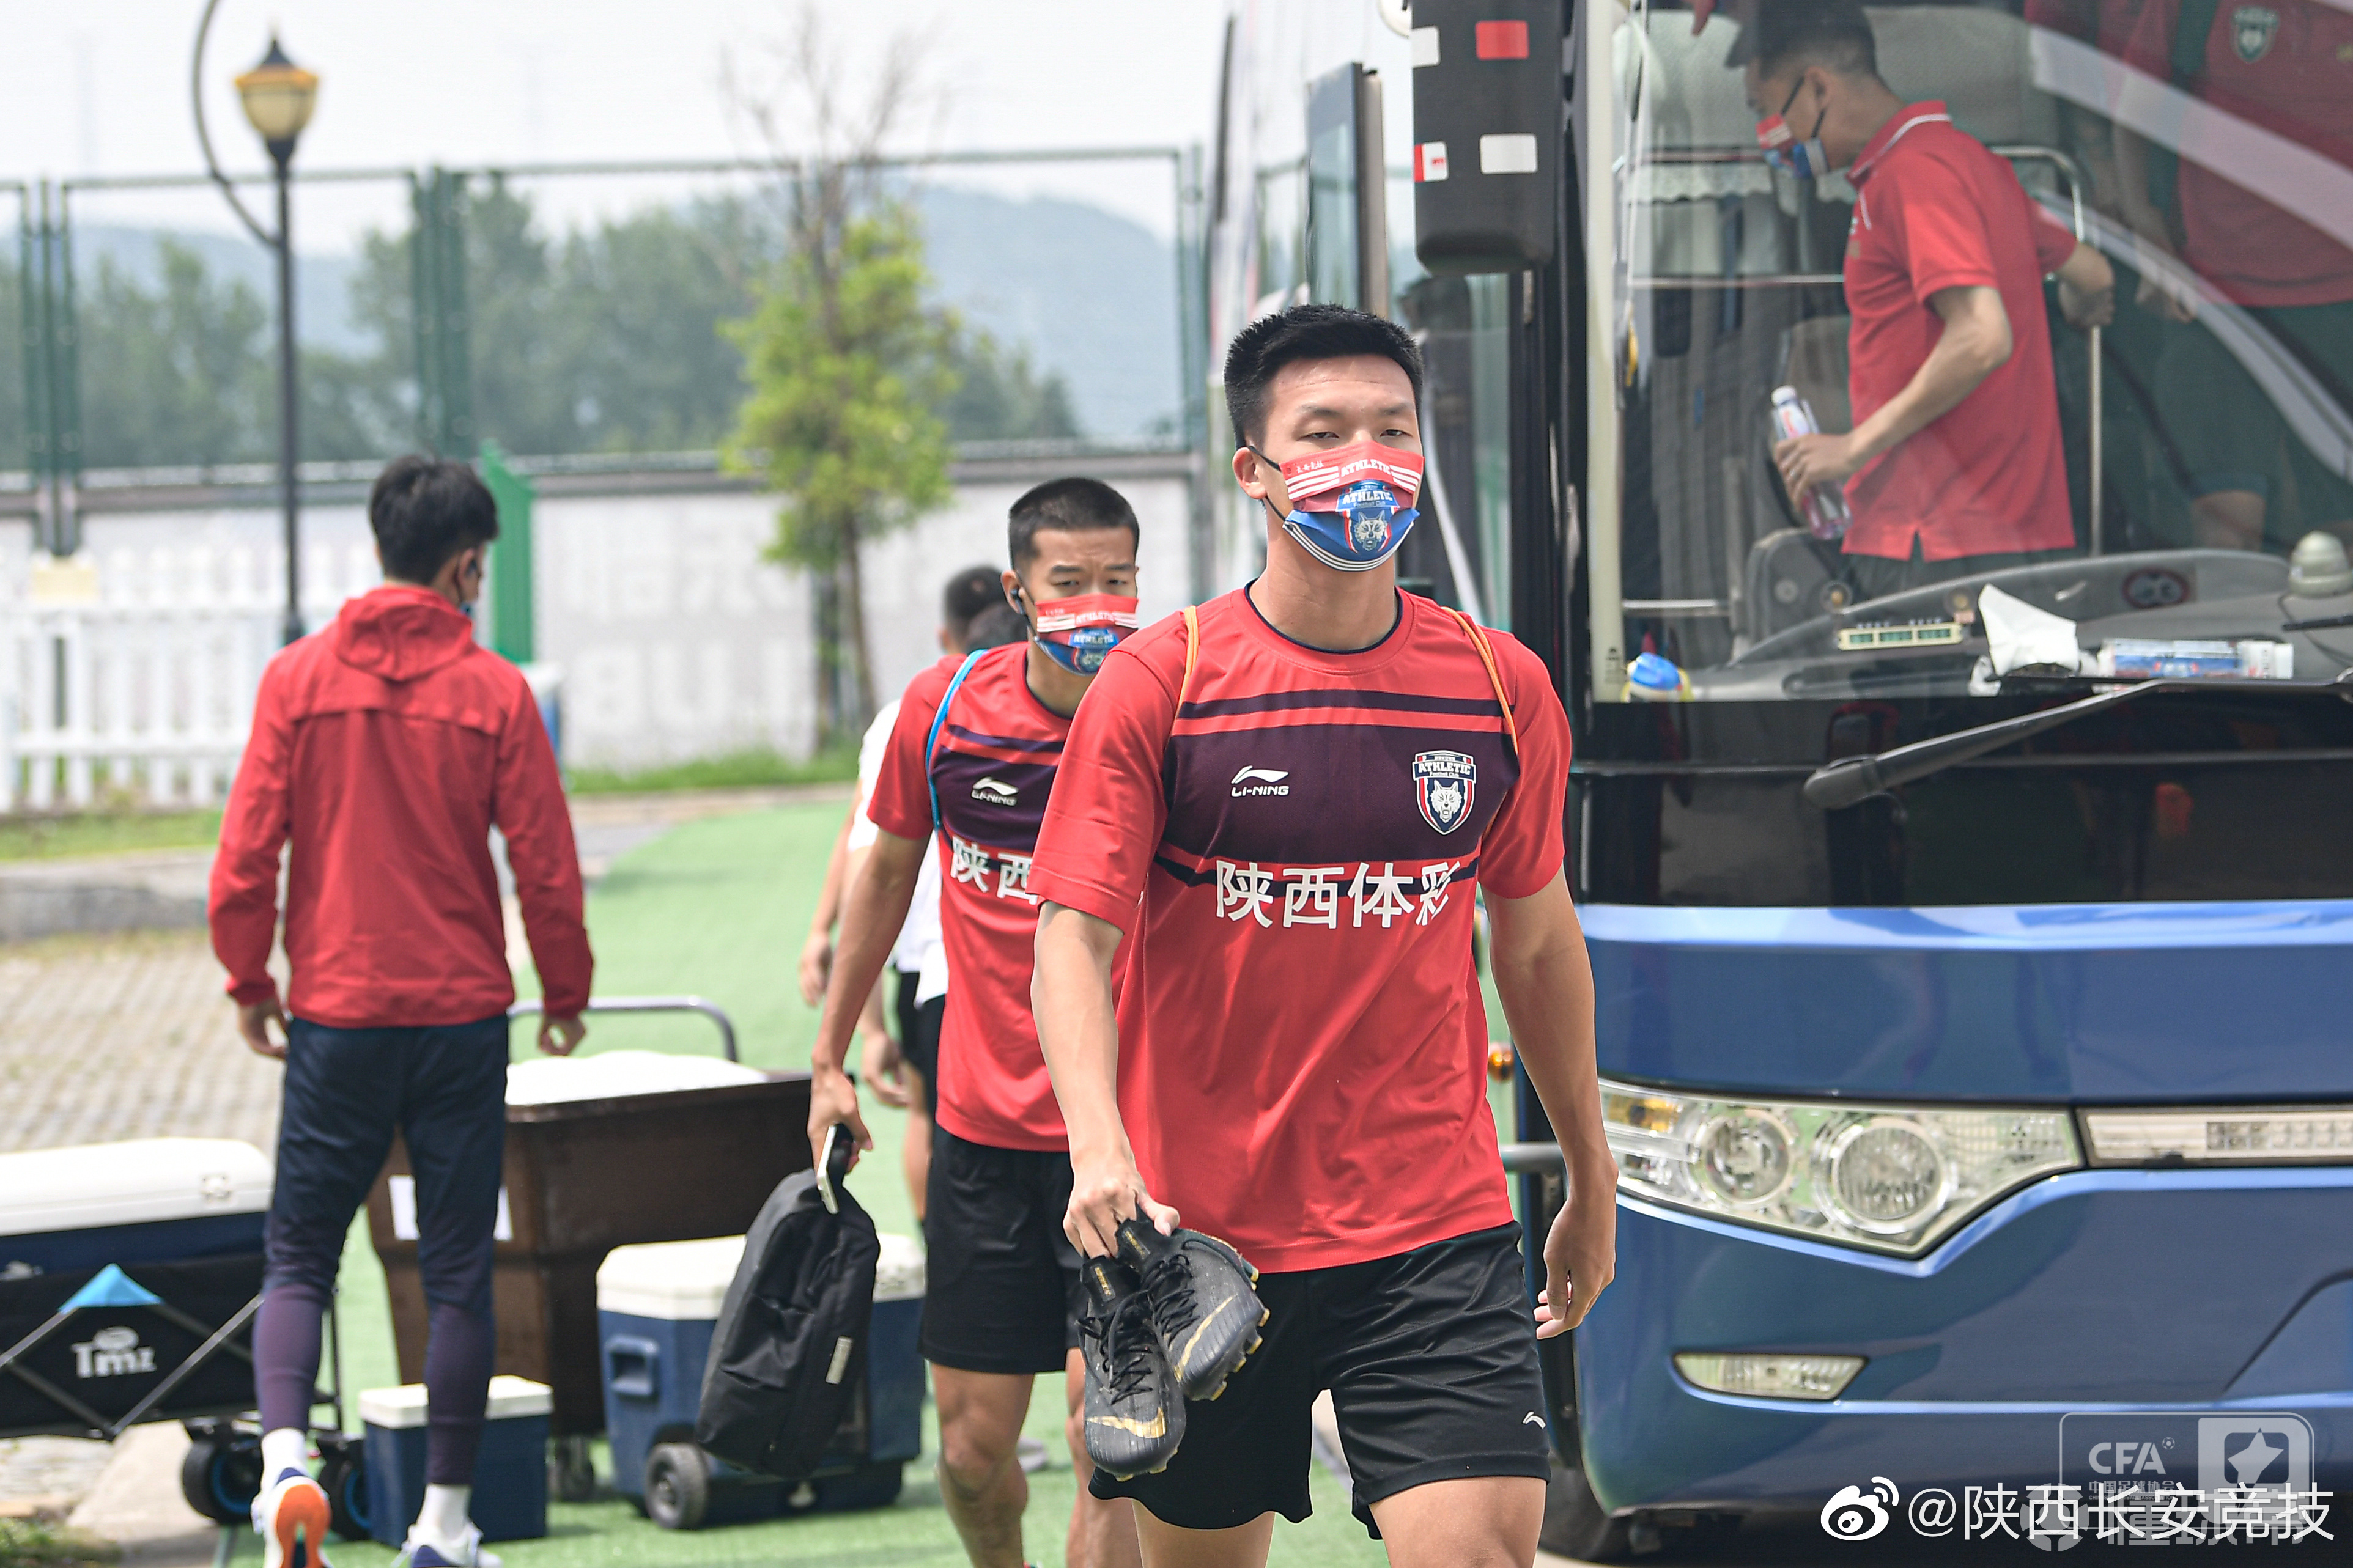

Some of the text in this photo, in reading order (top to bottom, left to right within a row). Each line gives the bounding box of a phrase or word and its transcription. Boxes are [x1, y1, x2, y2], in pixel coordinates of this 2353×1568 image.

[1341, 459, 1391, 477] ATHLETIC
[1342, 490, 1393, 504] ATHLETIC
[1419, 762, 1471, 775] ATHLETIC
[971, 789, 1018, 806] LI-NING
[1231, 786, 1290, 797] LI-NING
[1216, 860, 1460, 929] 陕西体彩
